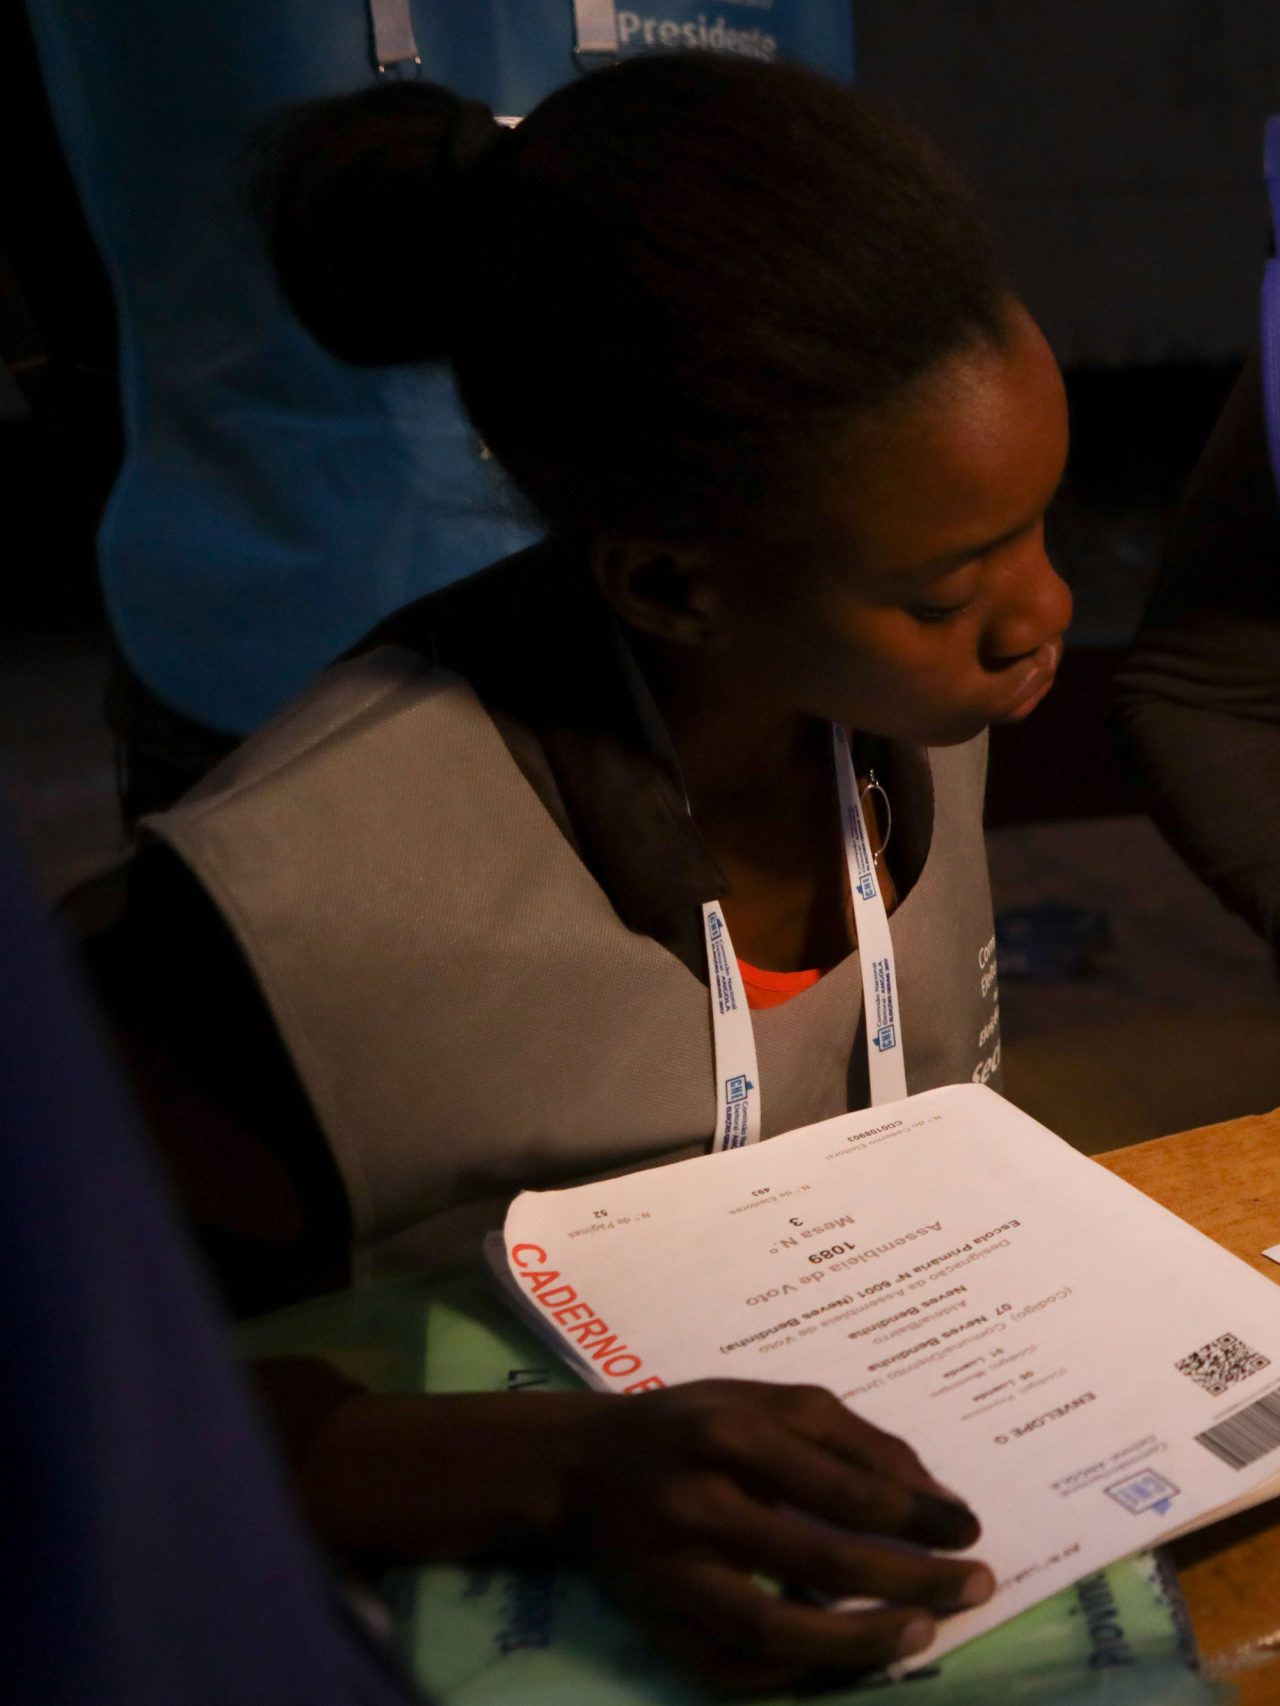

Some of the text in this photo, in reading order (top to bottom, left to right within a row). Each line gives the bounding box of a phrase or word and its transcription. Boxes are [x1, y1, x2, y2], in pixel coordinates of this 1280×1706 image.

[749, 1185, 770, 1197] 493
[591, 1208, 607, 1219] 52
[788, 1216, 803, 1227] 3
[798, 1214, 855, 1239] Mesa
[972, 1218, 1020, 1245] Escola
[745, 1220, 941, 1307] Assembleia de Voto
[806, 1239, 855, 1265] 1089
[912, 1244, 972, 1274] Primária
[757, 1238, 1010, 1353] Designação da Assembleia de Voto
[855, 1278, 891, 1299] 6001
[513, 1243, 641, 1375] CADERNO
[802, 1294, 853, 1320] (Neves
[847, 1284, 966, 1341] Neves Bendinha
[719, 1317, 799, 1355] Bendinha)
[866, 1302, 1012, 1373] 07 Neves Bendinha
[1009, 1391, 1096, 1438] ENVELOPE
